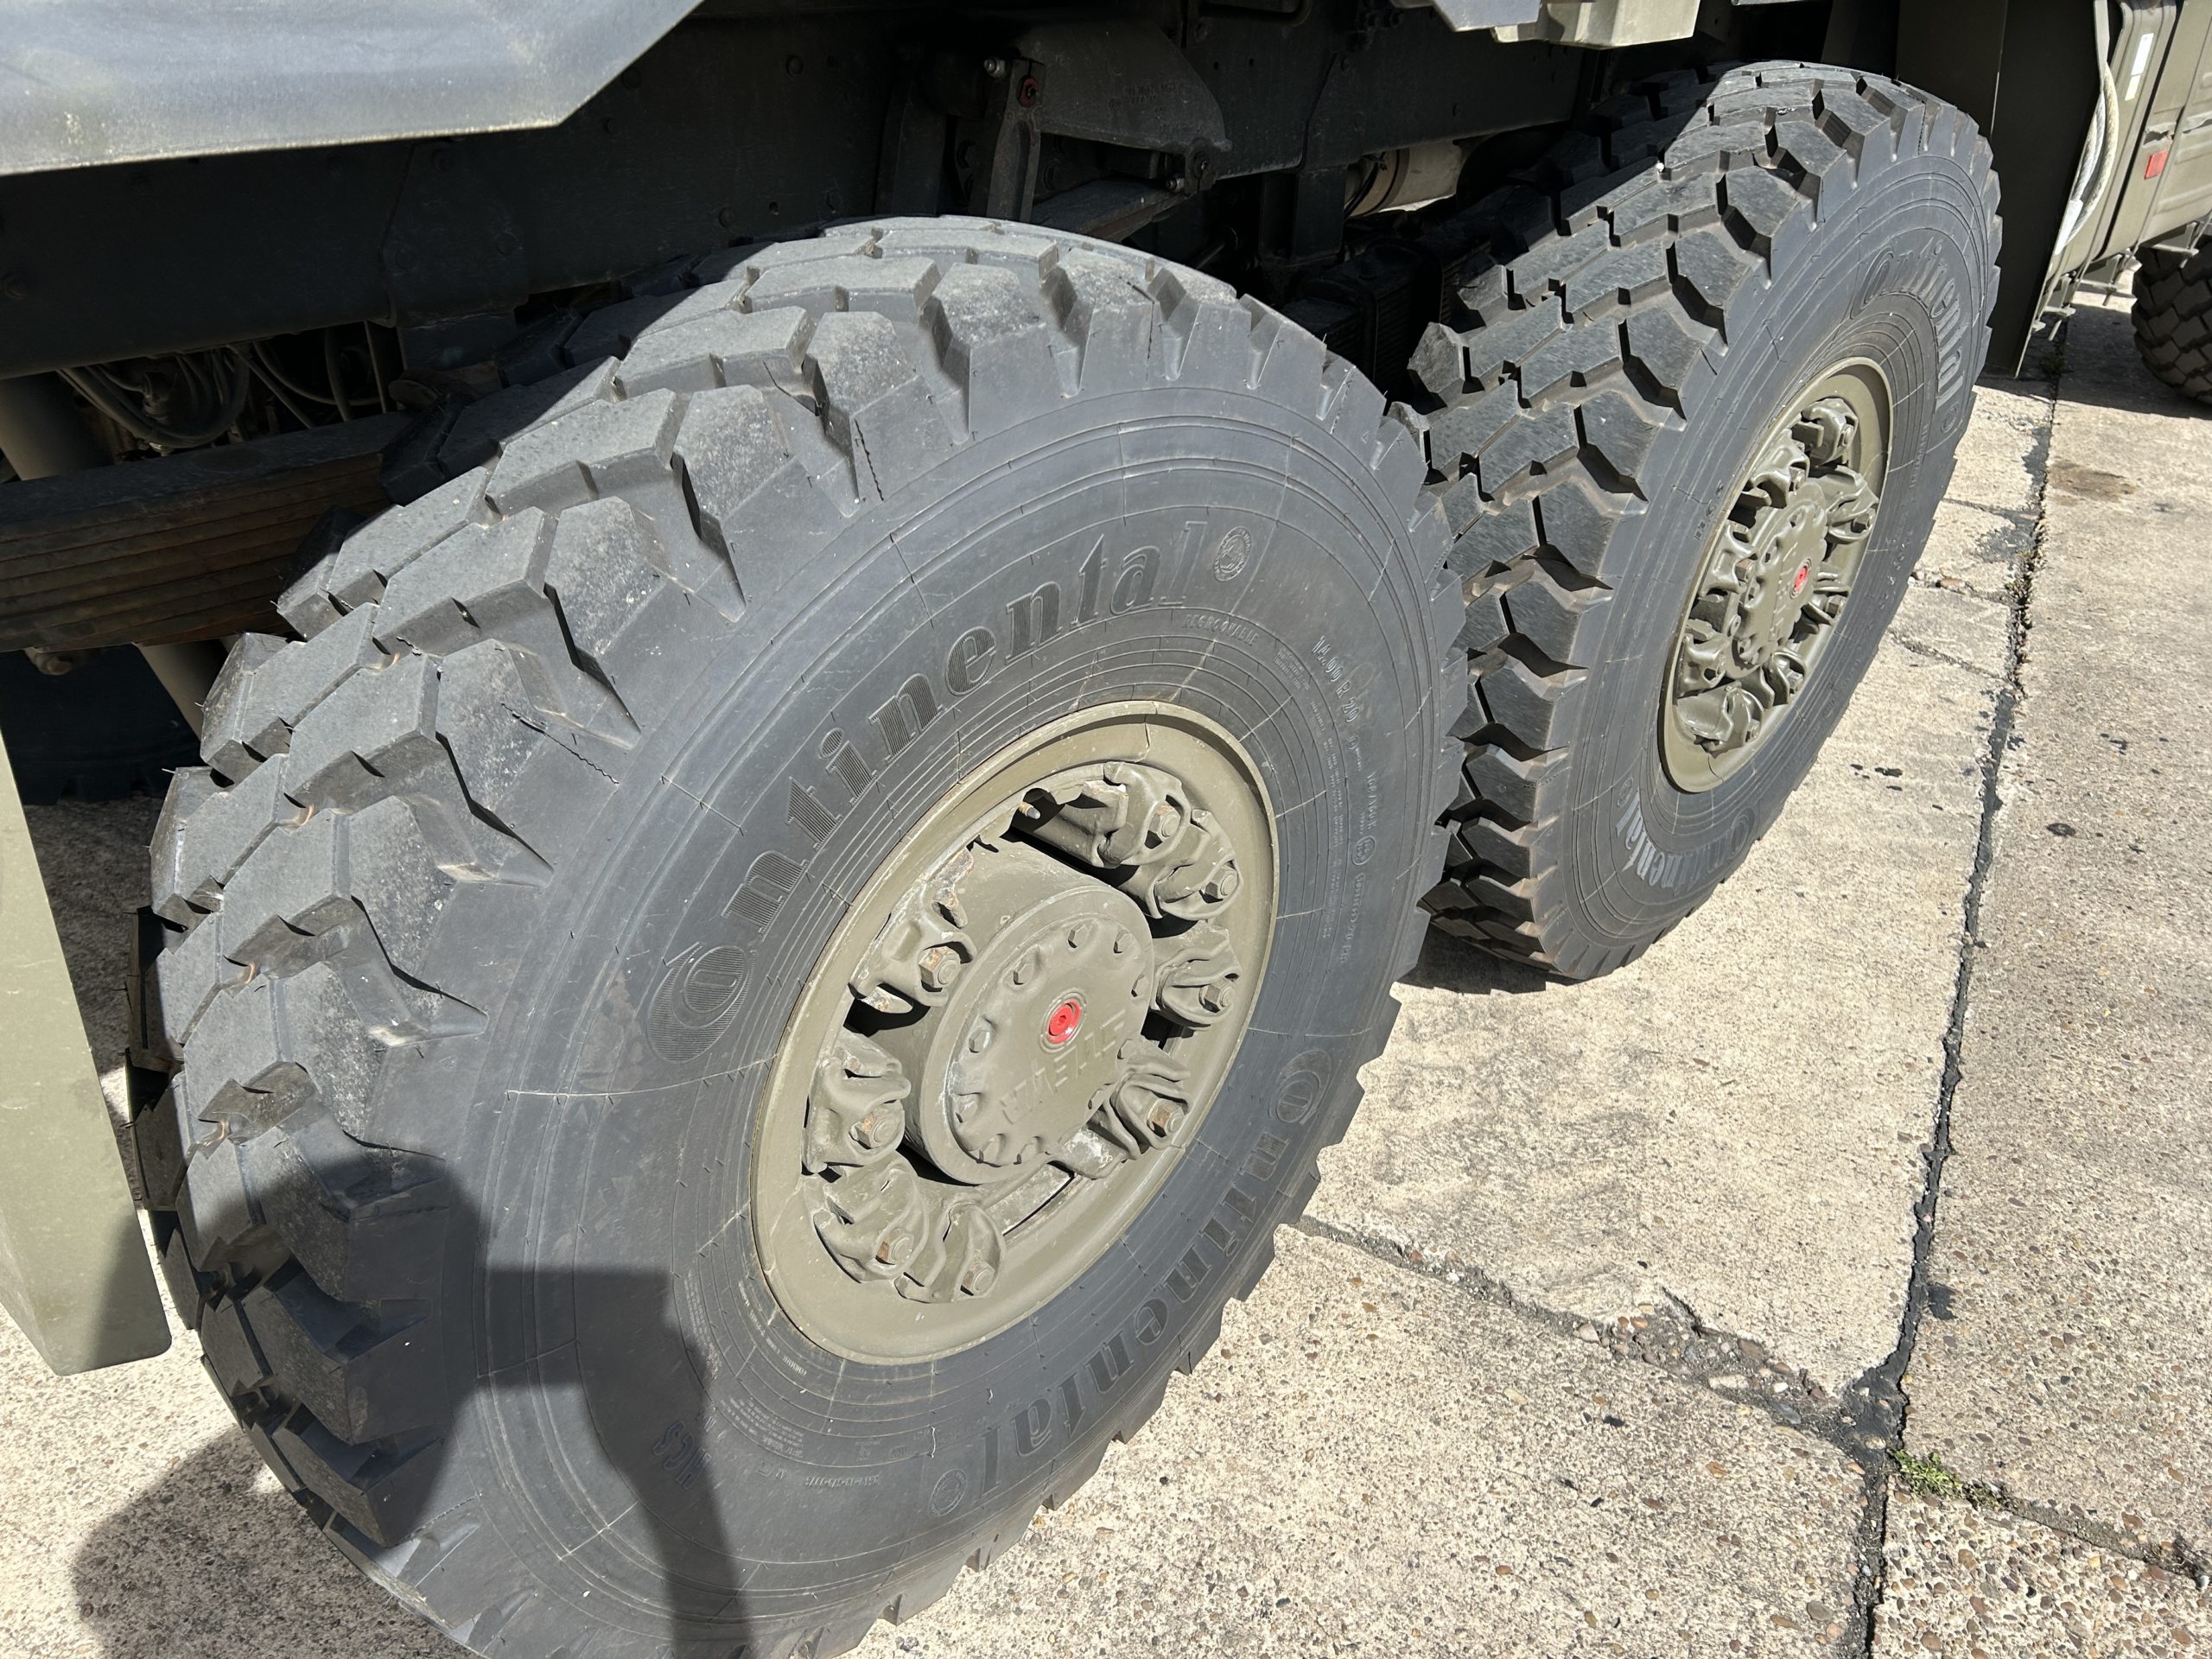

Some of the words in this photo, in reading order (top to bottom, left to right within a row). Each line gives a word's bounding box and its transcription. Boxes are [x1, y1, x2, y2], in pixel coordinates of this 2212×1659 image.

[1312, 635, 1345, 683] 14.00
[1335, 681, 1352, 699] R
[1340, 699, 1363, 723] 20
[649, 520, 1208, 1061] Continental
[980, 1049, 1334, 1497] Continental
[652, 1420, 714, 1491] HCS
